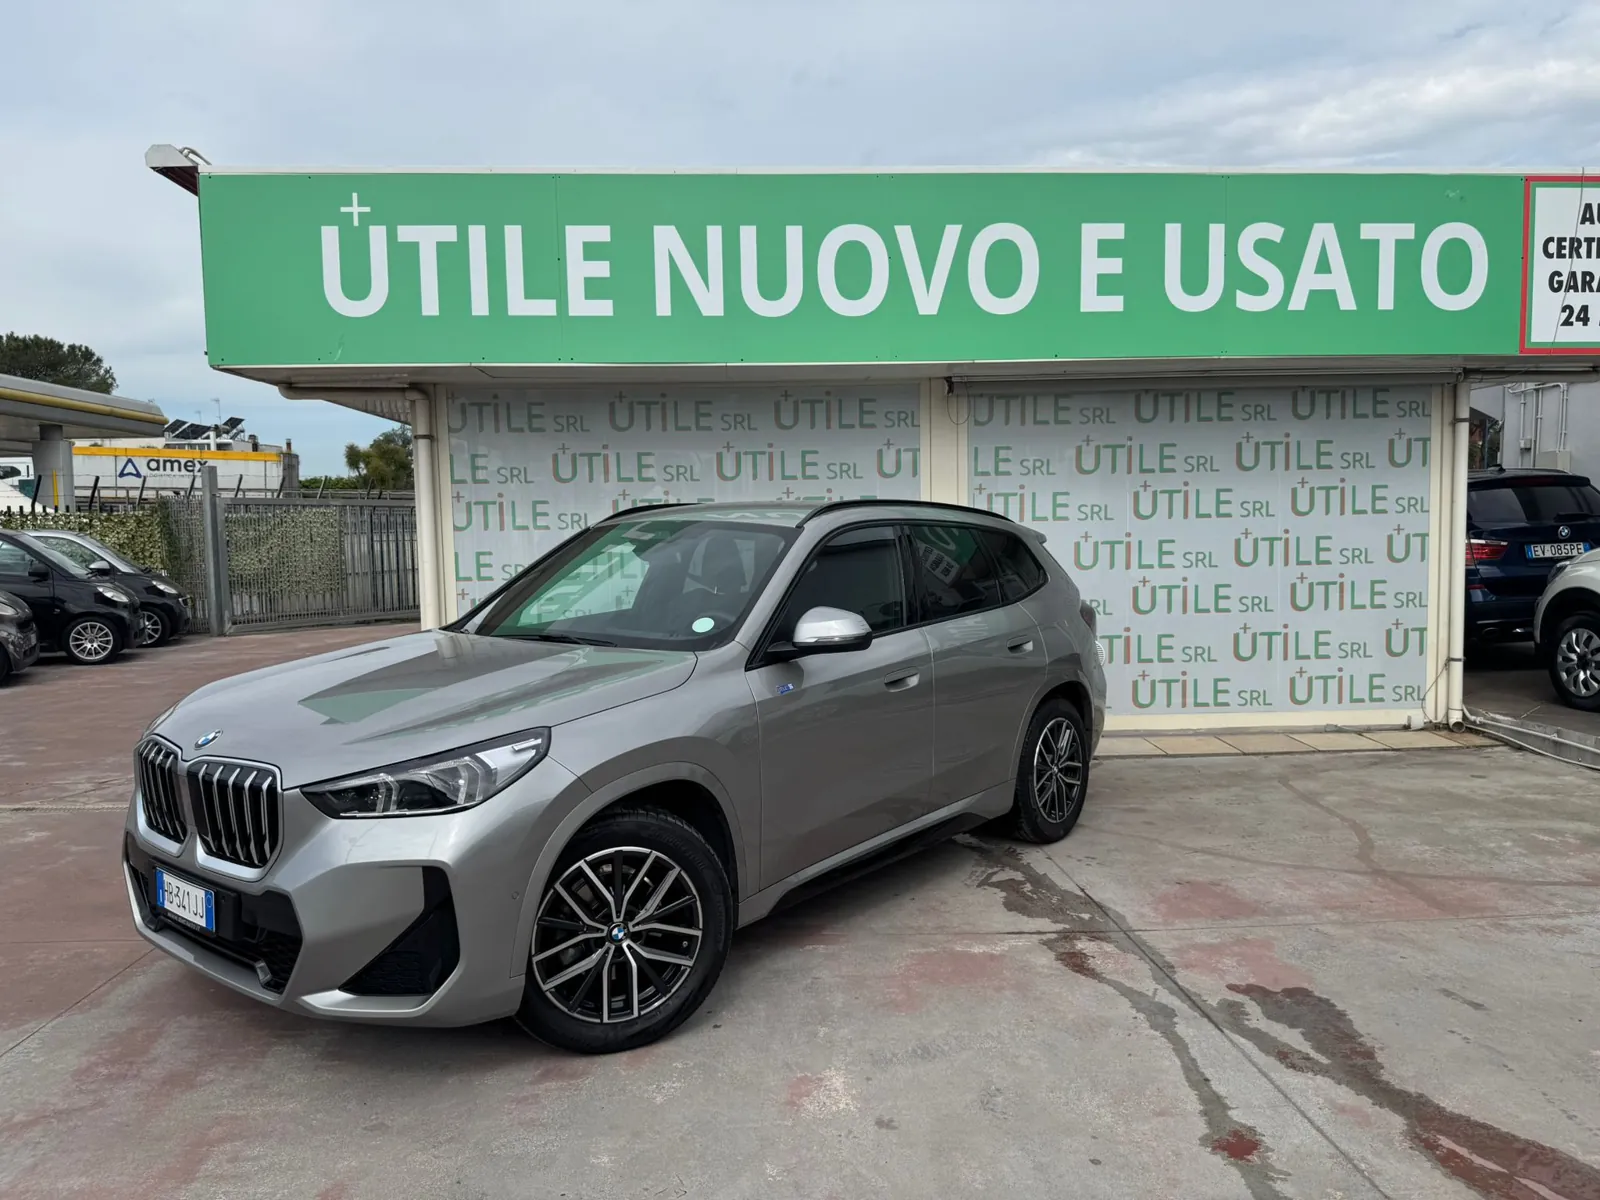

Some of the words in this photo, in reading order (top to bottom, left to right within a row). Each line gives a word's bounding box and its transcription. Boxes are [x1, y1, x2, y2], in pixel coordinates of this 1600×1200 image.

[654, 222, 1039, 317] NUOVO
[1080, 222, 1124, 313] E
[1165, 221, 1488, 313] USATO
[1549, 271, 1600, 292] GAR
[1561, 304, 1589, 326] 24
[1079, 408, 1116, 424] SRL
[1241, 404, 1277, 421] SRL
[1396, 400, 1431, 418] SRL
[554, 415, 590, 432] SRL
[721, 414, 757, 431] SRL
[884, 411, 920, 428] SRL
[147, 458, 208, 473] amex
[1018, 458, 1056, 476] SRL
[1184, 455, 1220, 472] SRL
[1340, 451, 1375, 469] SRL
[497, 467, 534, 484] SRL
[663, 465, 700, 482] SRL
[827, 462, 863, 479] SRL
[1077, 504, 1114, 521] SRL
[1240, 500, 1275, 517] SRL
[1395, 496, 1429, 514] SRL
[1182, 551, 1218, 568] SRL
[1339, 548, 1374, 564] SRL
[1238, 596, 1274, 613] SRL
[1393, 592, 1428, 608] SRL
[1181, 646, 1218, 662] SRL
[1338, 642, 1373, 659] SRL
[1237, 690, 1273, 706] SRL
[1392, 685, 1426, 702] SRL
